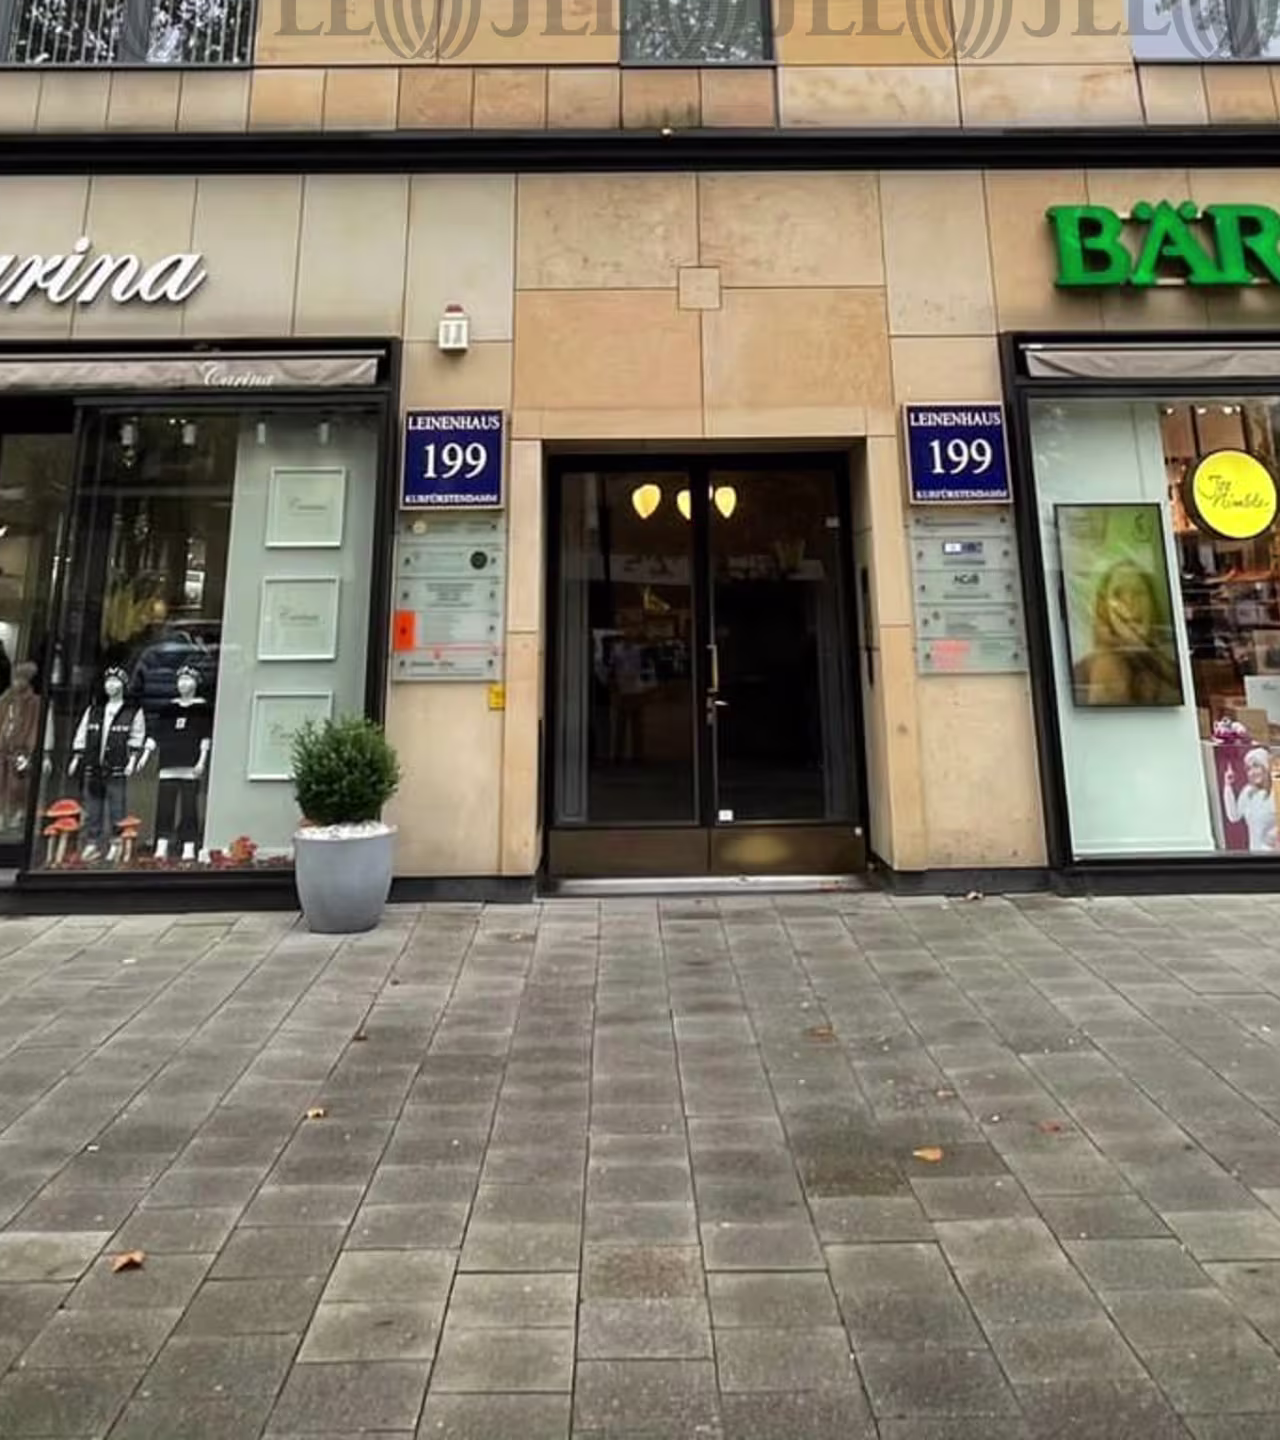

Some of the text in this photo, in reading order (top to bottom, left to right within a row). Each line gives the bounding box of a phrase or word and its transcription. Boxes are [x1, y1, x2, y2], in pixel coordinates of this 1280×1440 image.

[201, 361, 274, 387] Carina
[408, 415, 500, 430] LEINENHAUS
[910, 412, 1001, 426] LEINENHAUS
[423, 442, 487, 479] 199
[929, 438, 993, 475] 199
